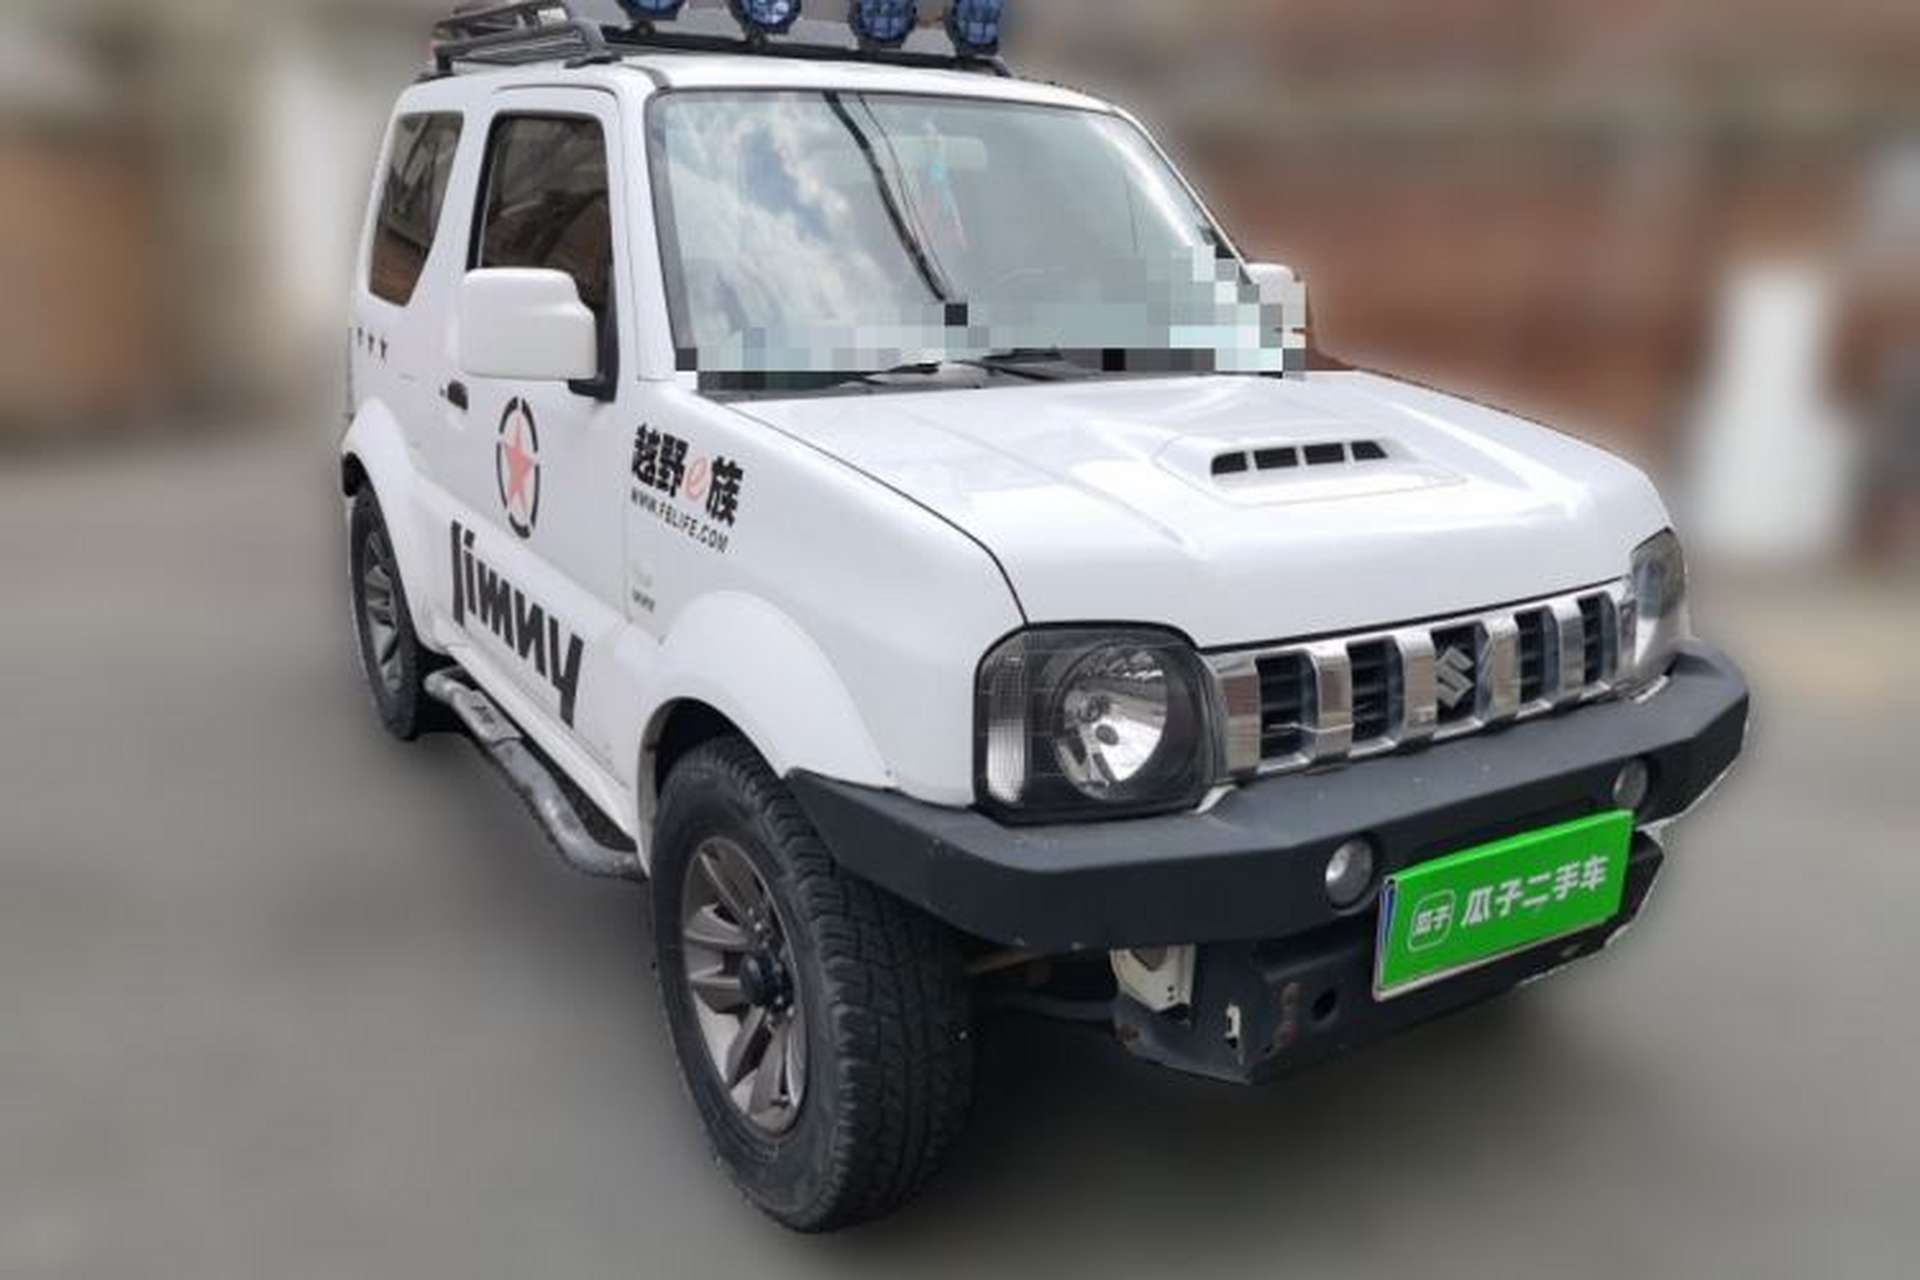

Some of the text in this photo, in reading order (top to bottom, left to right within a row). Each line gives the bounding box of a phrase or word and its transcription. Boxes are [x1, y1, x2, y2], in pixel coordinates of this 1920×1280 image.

[1460, 854, 1610, 928] 瓜子二手车
